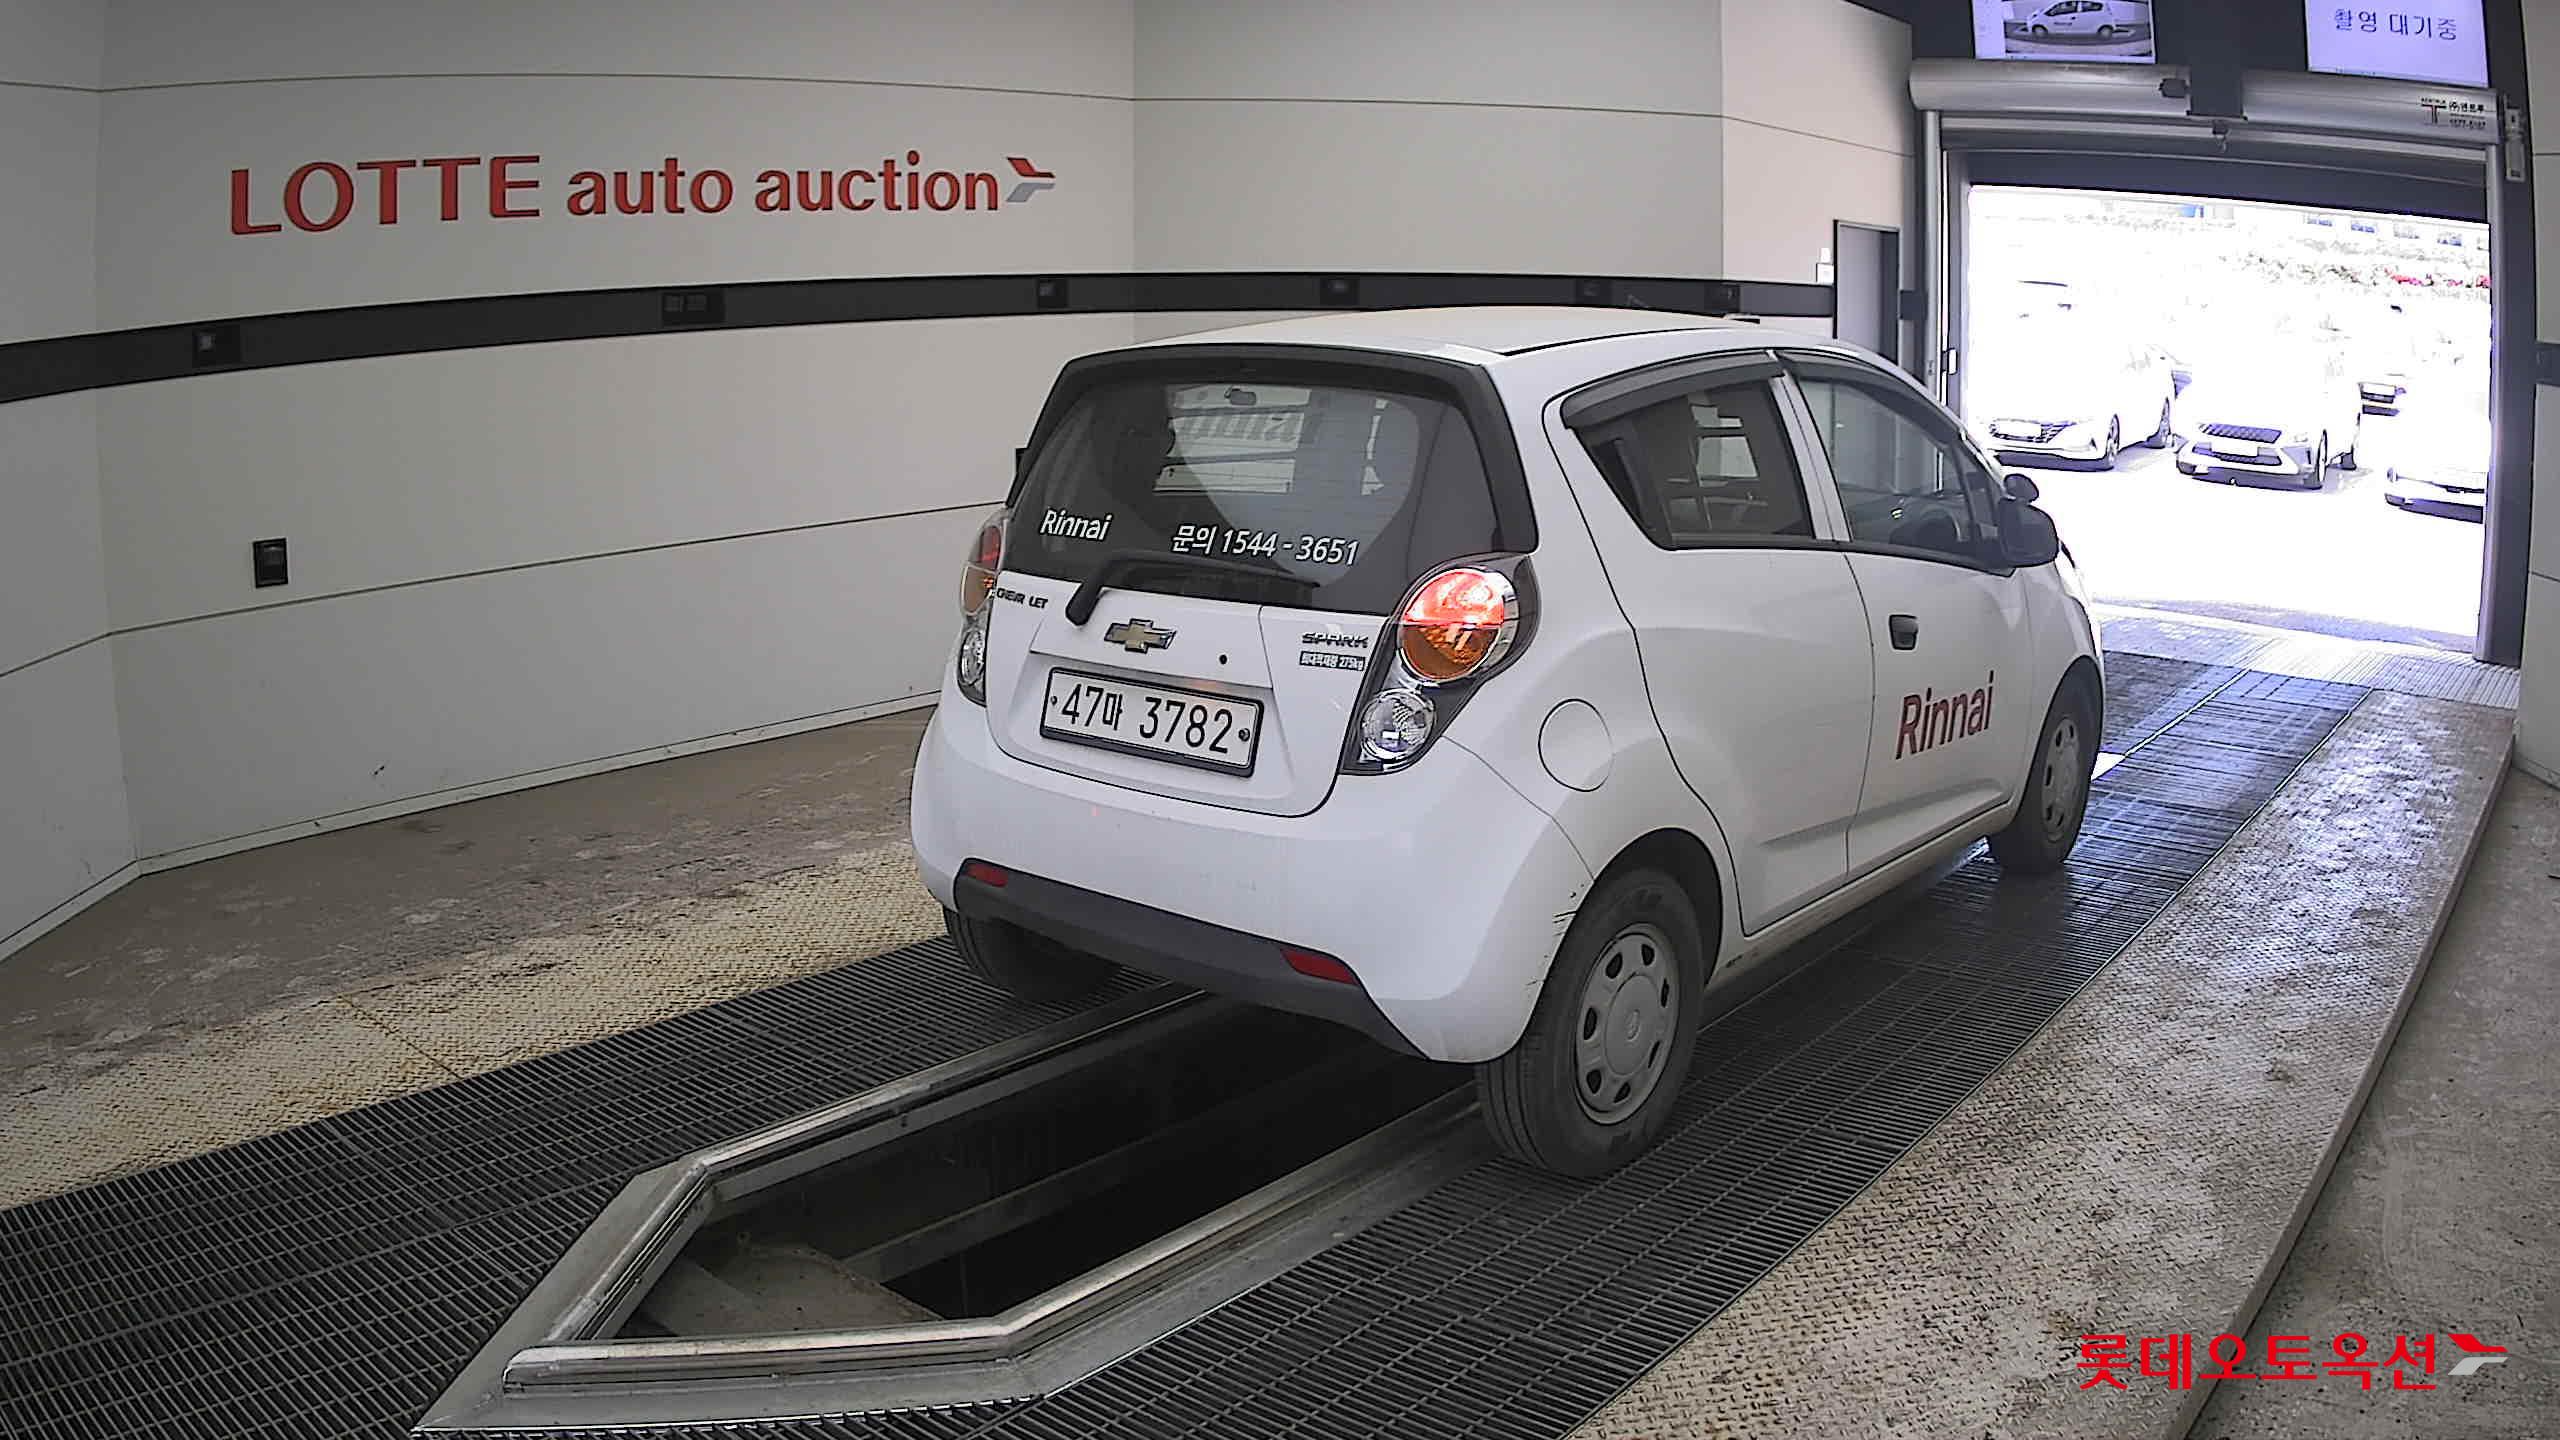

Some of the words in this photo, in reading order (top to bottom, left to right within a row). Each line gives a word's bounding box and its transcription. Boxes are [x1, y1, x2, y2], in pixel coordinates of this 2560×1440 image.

[2335, 8, 2377, 32] 촬영
[2389, 13, 2457, 41] 대기중
[231, 155, 540, 235] LOTTE
[566, 157, 734, 216] auto
[754, 150, 1001, 211] auction
[1039, 509, 1113, 541] Rinnai
[1171, 524, 1217, 555] 문의
[1222, 529, 1278, 557] 1544
[1295, 535, 1360, 565] 3651
[1301, 632, 1369, 649] SPARK
[1061, 683, 1124, 731] 47마
[1139, 696, 1234, 754] 3782
[1895, 669, 1995, 760] Rinnai
